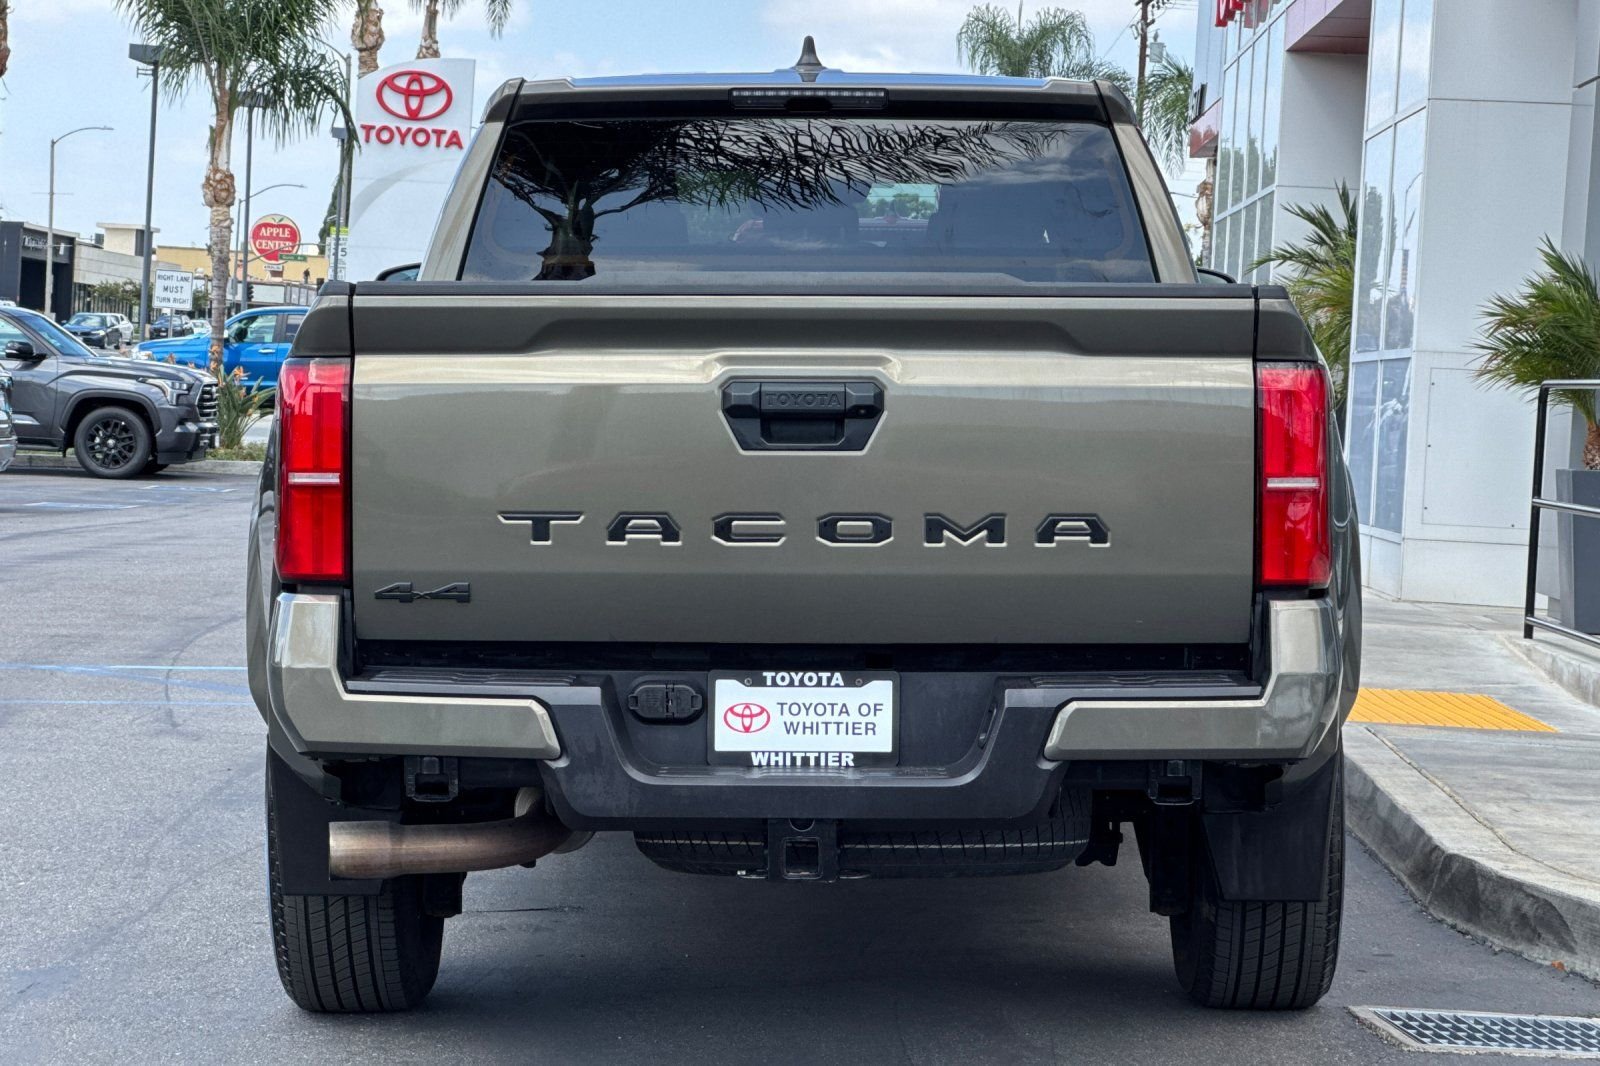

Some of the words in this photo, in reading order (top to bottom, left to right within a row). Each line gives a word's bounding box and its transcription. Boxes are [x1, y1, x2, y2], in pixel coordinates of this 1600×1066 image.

[360, 124, 464, 150] TOYOTA
[259, 227, 291, 238] APPLE
[256, 239, 292, 251] CENTER
[176, 275, 191, 283] LANE
[162, 285, 184, 294] MUST
[172, 297, 189, 305] RIGHT
[765, 393, 841, 407] TOYOTA
[496, 511, 1111, 548] TACOMA
[762, 671, 845, 687] TOYOTA
[776, 702, 851, 717] TOYOTA
[857, 703, 884, 717] OF
[783, 721, 877, 736] WHITTIER
[750, 752, 855, 767] WHITTIER
